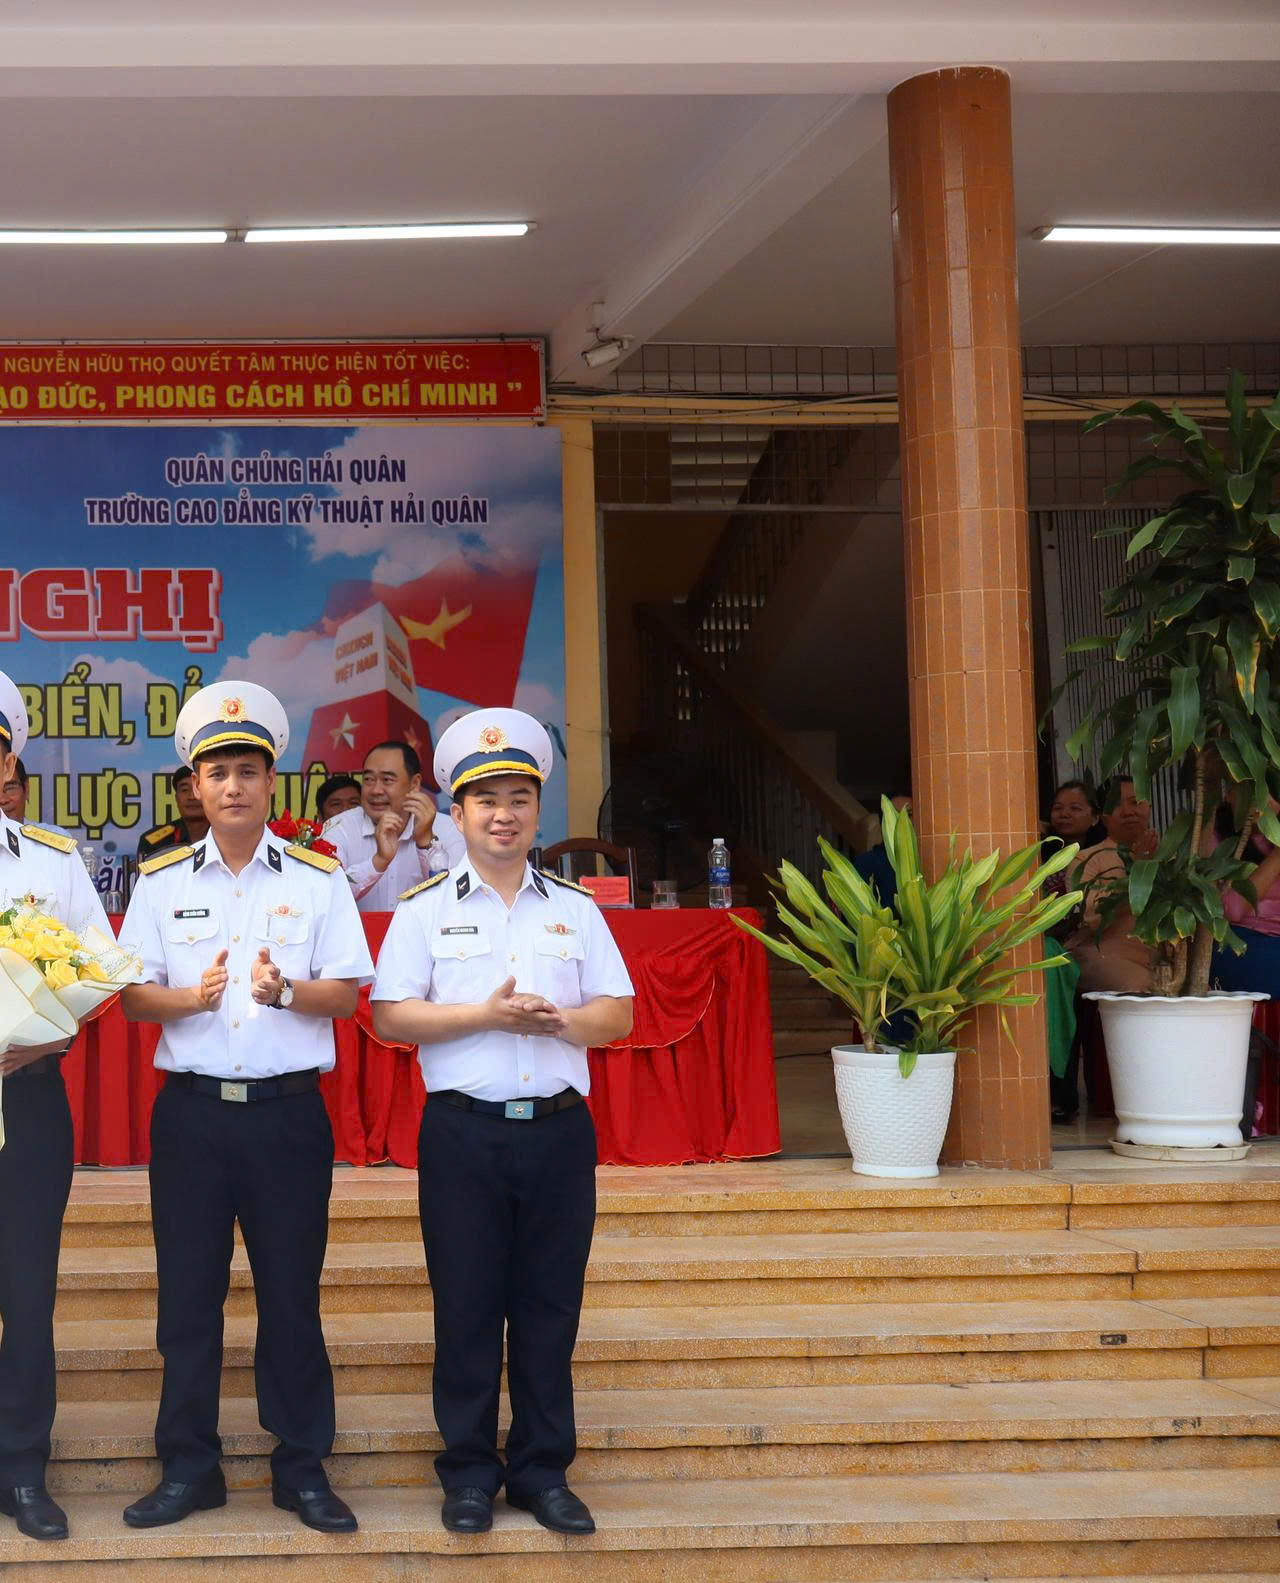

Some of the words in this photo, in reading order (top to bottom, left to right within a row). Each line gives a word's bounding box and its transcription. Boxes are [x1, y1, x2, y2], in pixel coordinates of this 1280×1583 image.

[4, 350, 80, 373] NGUYỄN
[86, 353, 123, 373] HỮU
[129, 356, 166, 374] THỌ
[172, 350, 231, 372] QUYẾT
[236, 352, 275, 371] TÂM
[281, 354, 329, 373] THỰC
[336, 351, 376, 373] HIỆN
[382, 349, 416, 370] TỐT
[423, 351, 470, 372] VIỆC:
[39, 381, 106, 412] ĐỨC,
[116, 384, 216, 408] PHONG
[226, 379, 304, 407] CÁCH
[314, 377, 353, 406] HỒ
[362, 379, 410, 406] CHÍ
[420, 383, 497, 406] MINH
[165, 452, 224, 486] QUÂN
[230, 452, 302, 484] CHỦNG
[307, 452, 346, 484] HẢI
[350, 452, 407, 484] QUÂN
[85, 493, 171, 527] TRƯỜNG
[175, 498, 219, 526] CAO
[222, 487, 286, 526] ĐẲNG
[288, 493, 317, 525] KỸ
[321, 494, 387, 530] THUẬT
[391, 490, 427, 525] HẢI
[432, 493, 488, 526] QUÂN
[54, 767, 142, 840] LỰC
